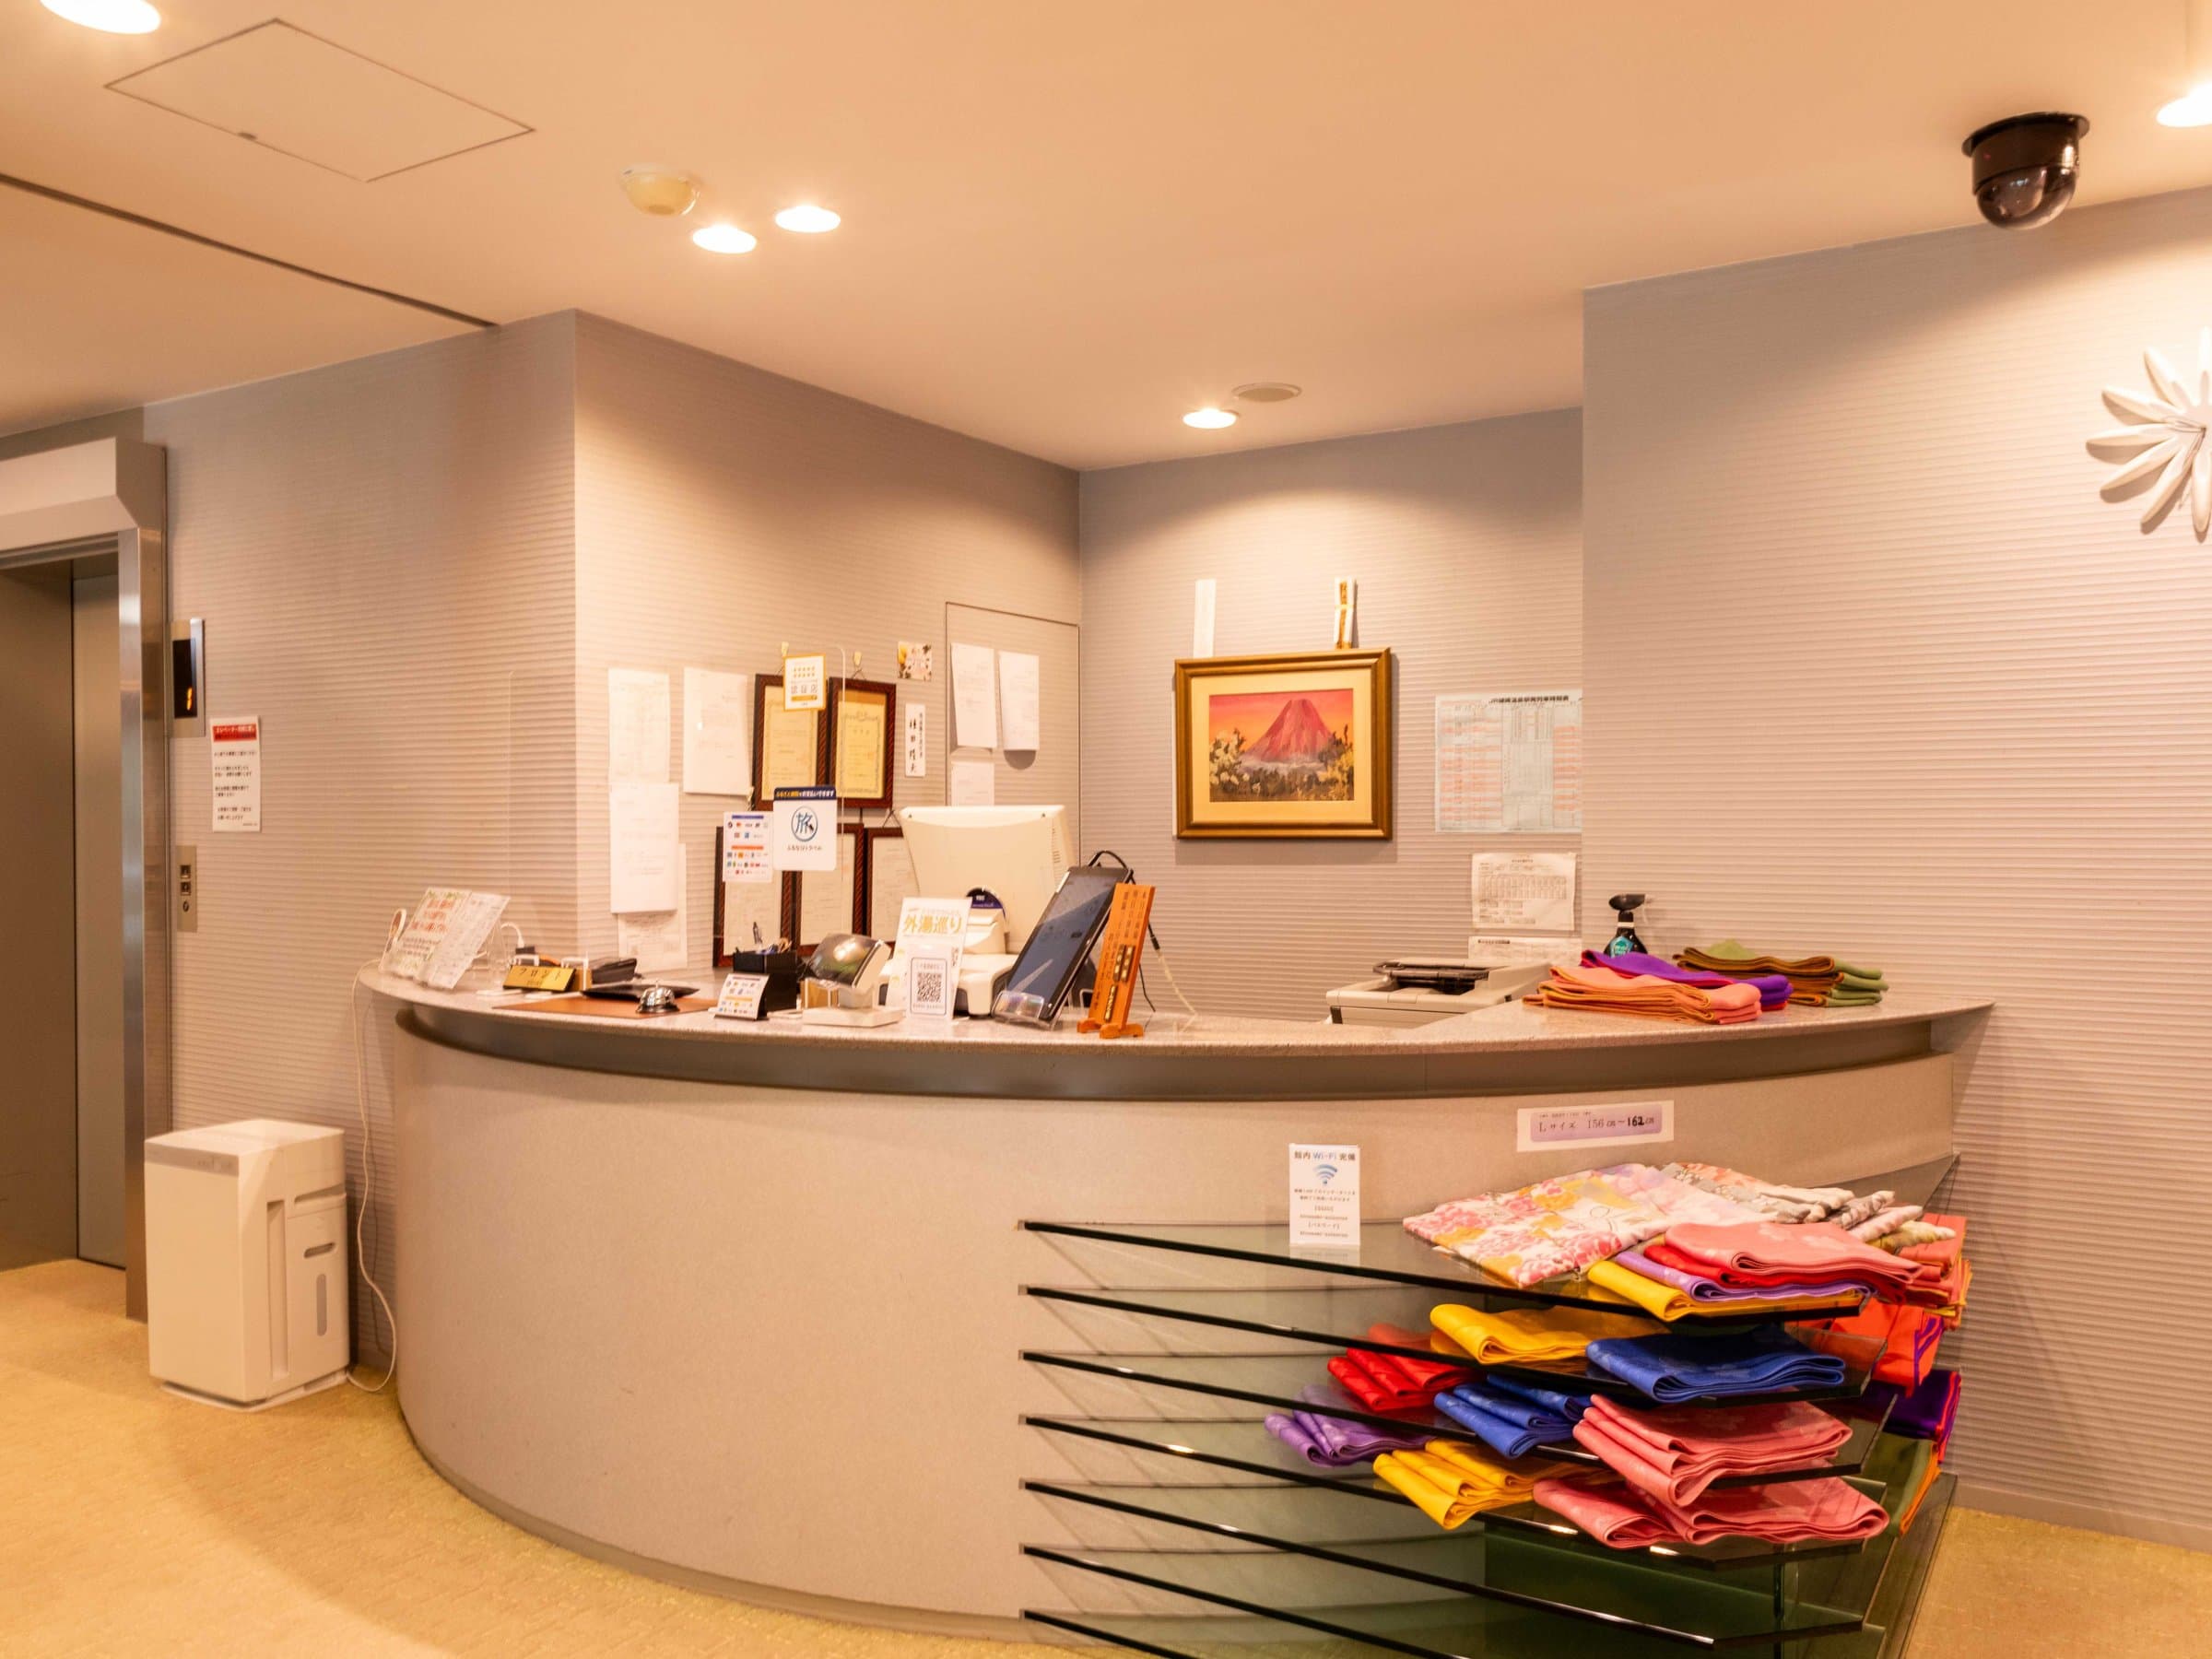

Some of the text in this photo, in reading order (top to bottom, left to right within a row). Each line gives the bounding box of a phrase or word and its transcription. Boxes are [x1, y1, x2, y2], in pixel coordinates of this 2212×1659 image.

[902, 913, 963, 935] 外湯巡り
[1312, 1150, 1336, 1160] Wi-Fi
